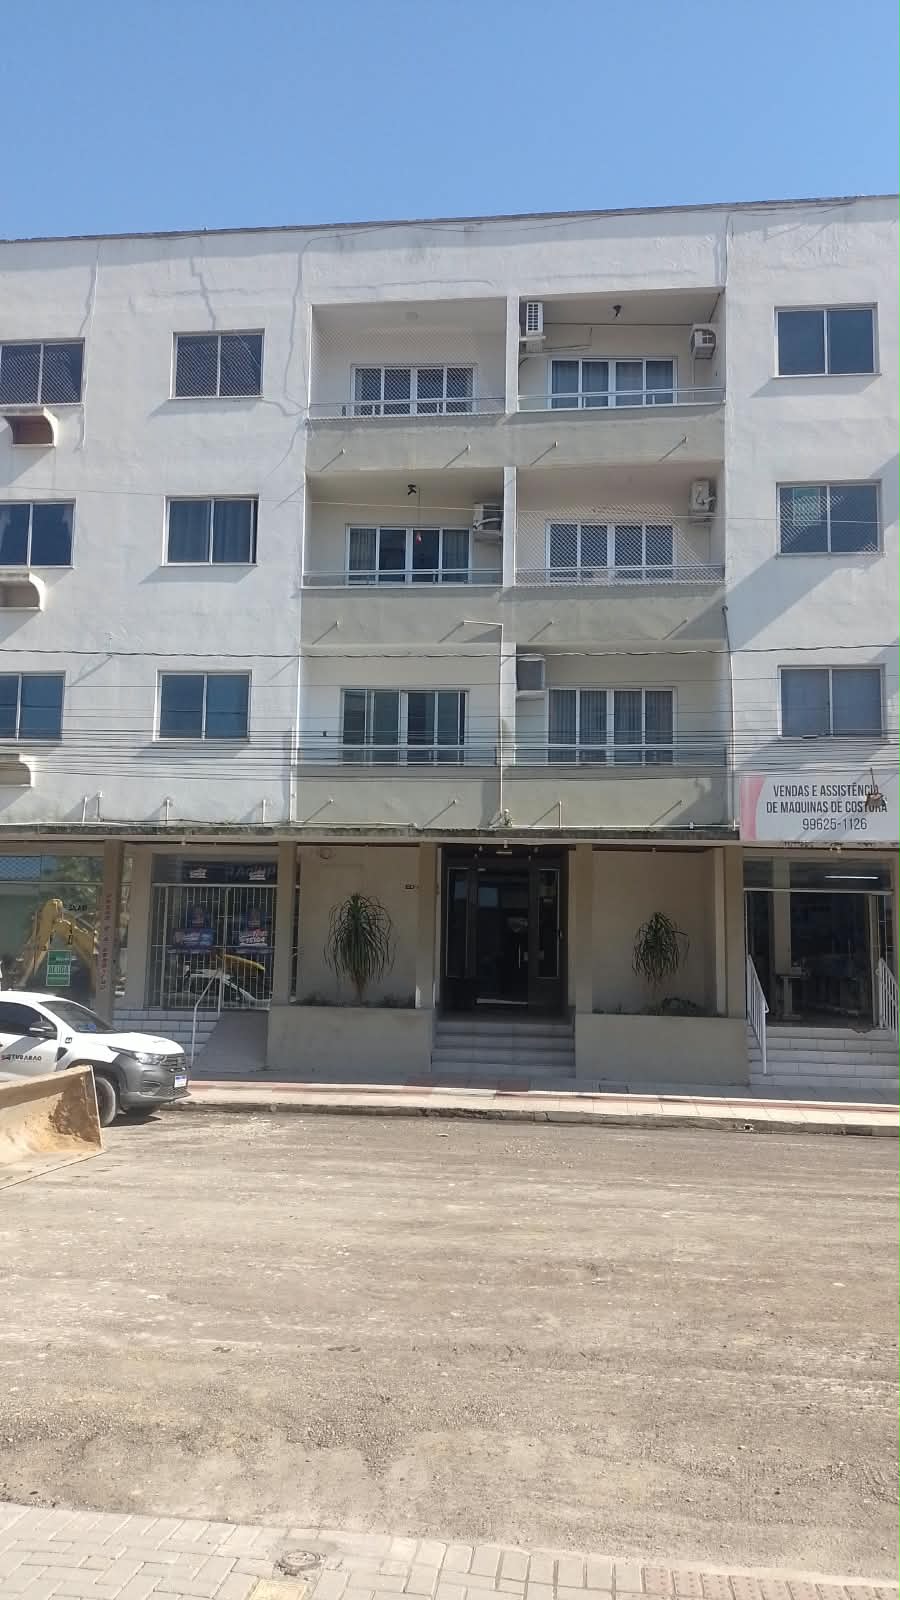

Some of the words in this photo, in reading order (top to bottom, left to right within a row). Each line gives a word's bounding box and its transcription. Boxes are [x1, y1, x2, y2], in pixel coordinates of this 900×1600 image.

[773, 785, 810, 797] VENDAS
[812, 785, 818, 797] E
[766, 801, 778, 813] DE
[831, 801, 843, 813] DE
[802, 817, 867, 831] 99625-1126
